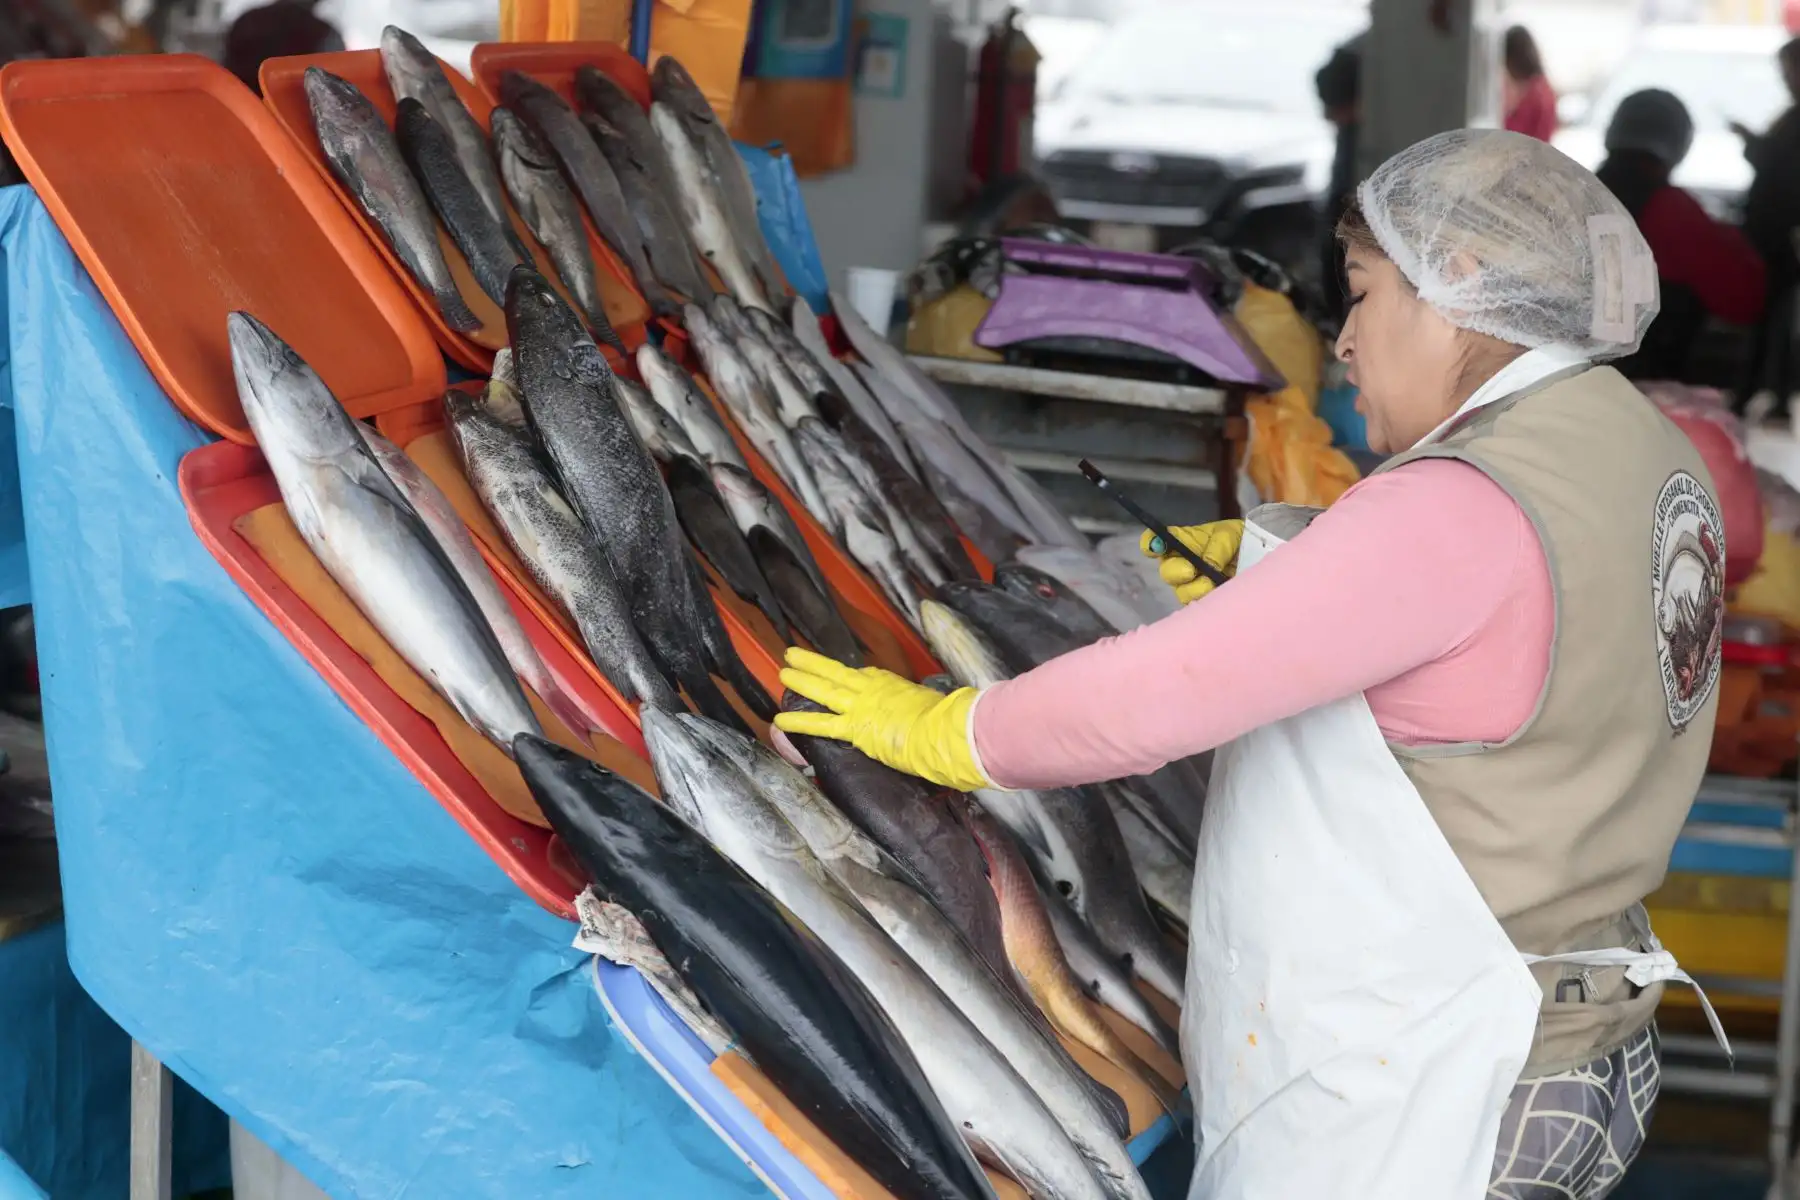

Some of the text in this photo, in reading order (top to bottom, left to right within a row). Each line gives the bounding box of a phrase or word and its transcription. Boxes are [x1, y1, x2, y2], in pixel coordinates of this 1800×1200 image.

[1657, 477, 1685, 527] ARTESANAL
[1685, 478, 1693, 497] DE
[1668, 499, 1700, 527] CARMENCITA
[1653, 521, 1664, 582] MUELLE
